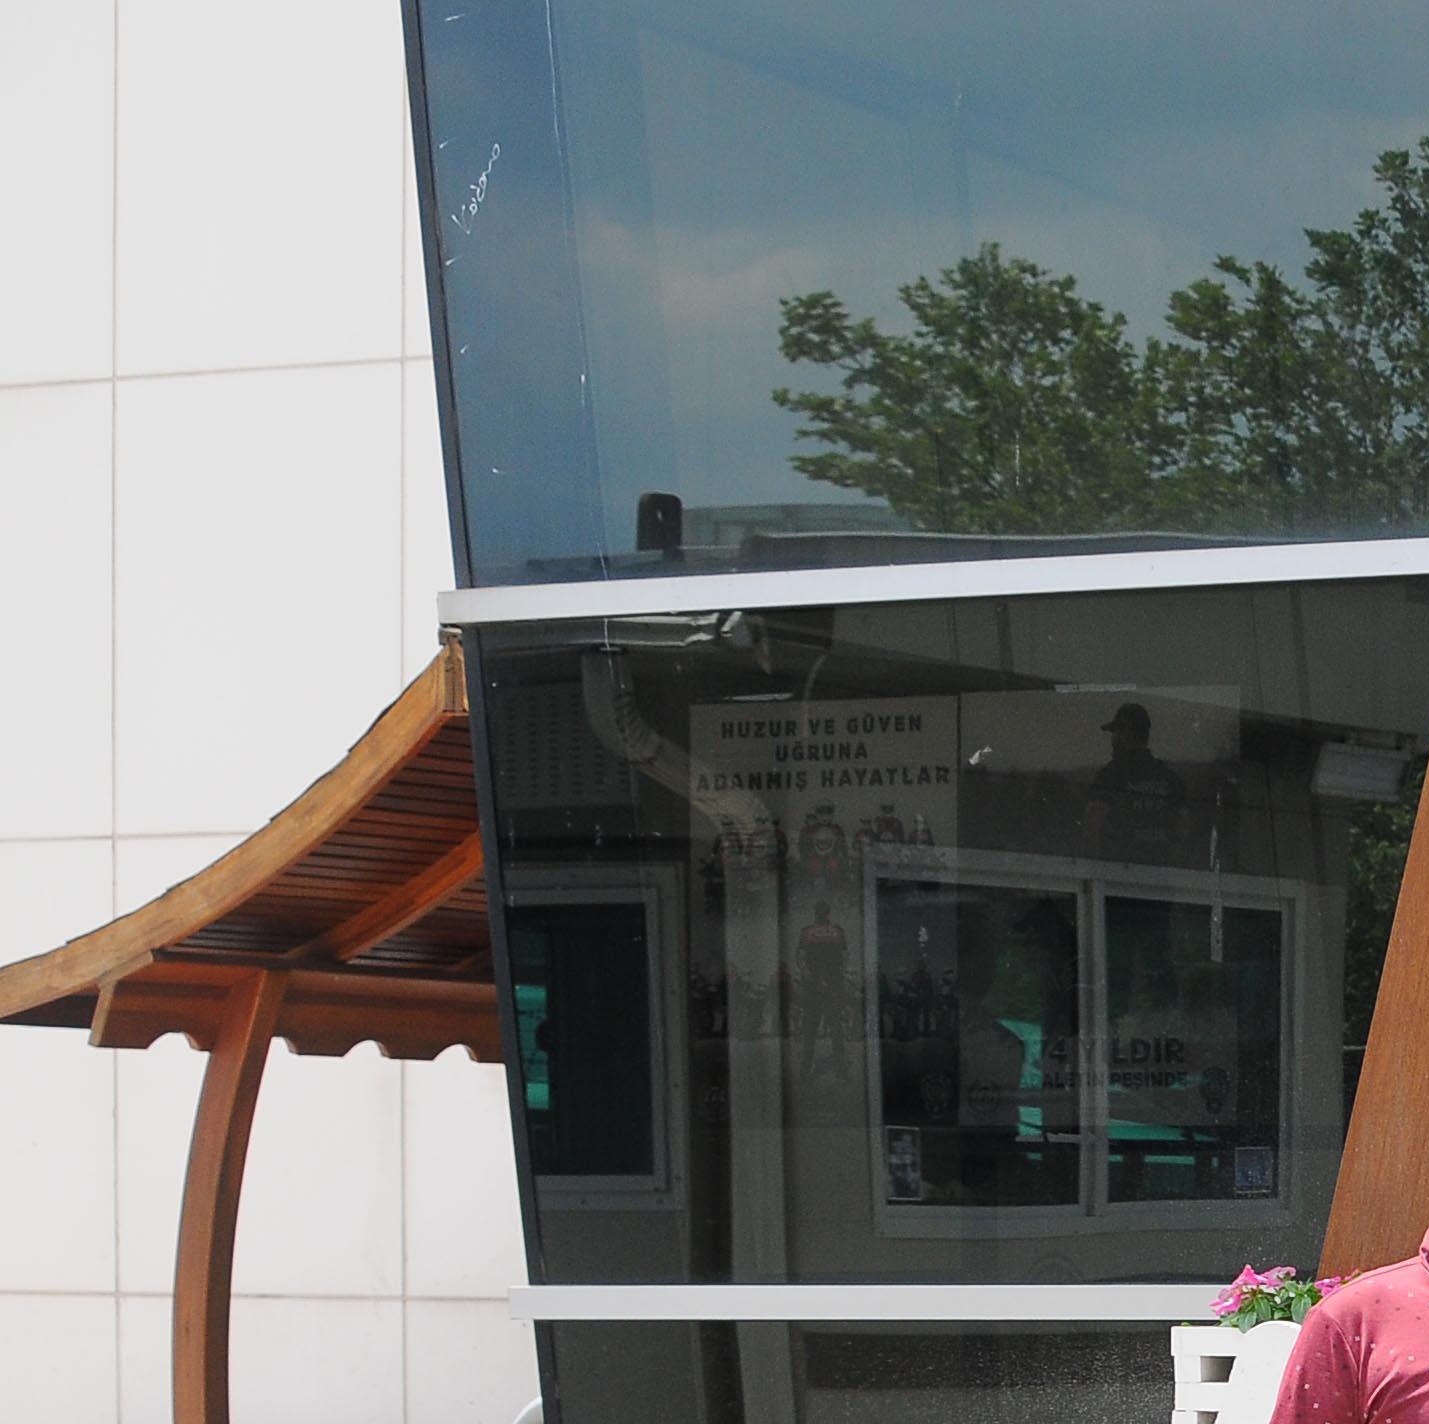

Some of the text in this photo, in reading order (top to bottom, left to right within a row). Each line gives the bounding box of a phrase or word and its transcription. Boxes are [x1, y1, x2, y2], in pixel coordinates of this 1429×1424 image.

[721, 713, 921, 739] HUZUR VE GÜVEN
[775, 741, 868, 762] UĞRUNA
[697, 765, 950, 792] ADANMIŞ HAYATLAR
